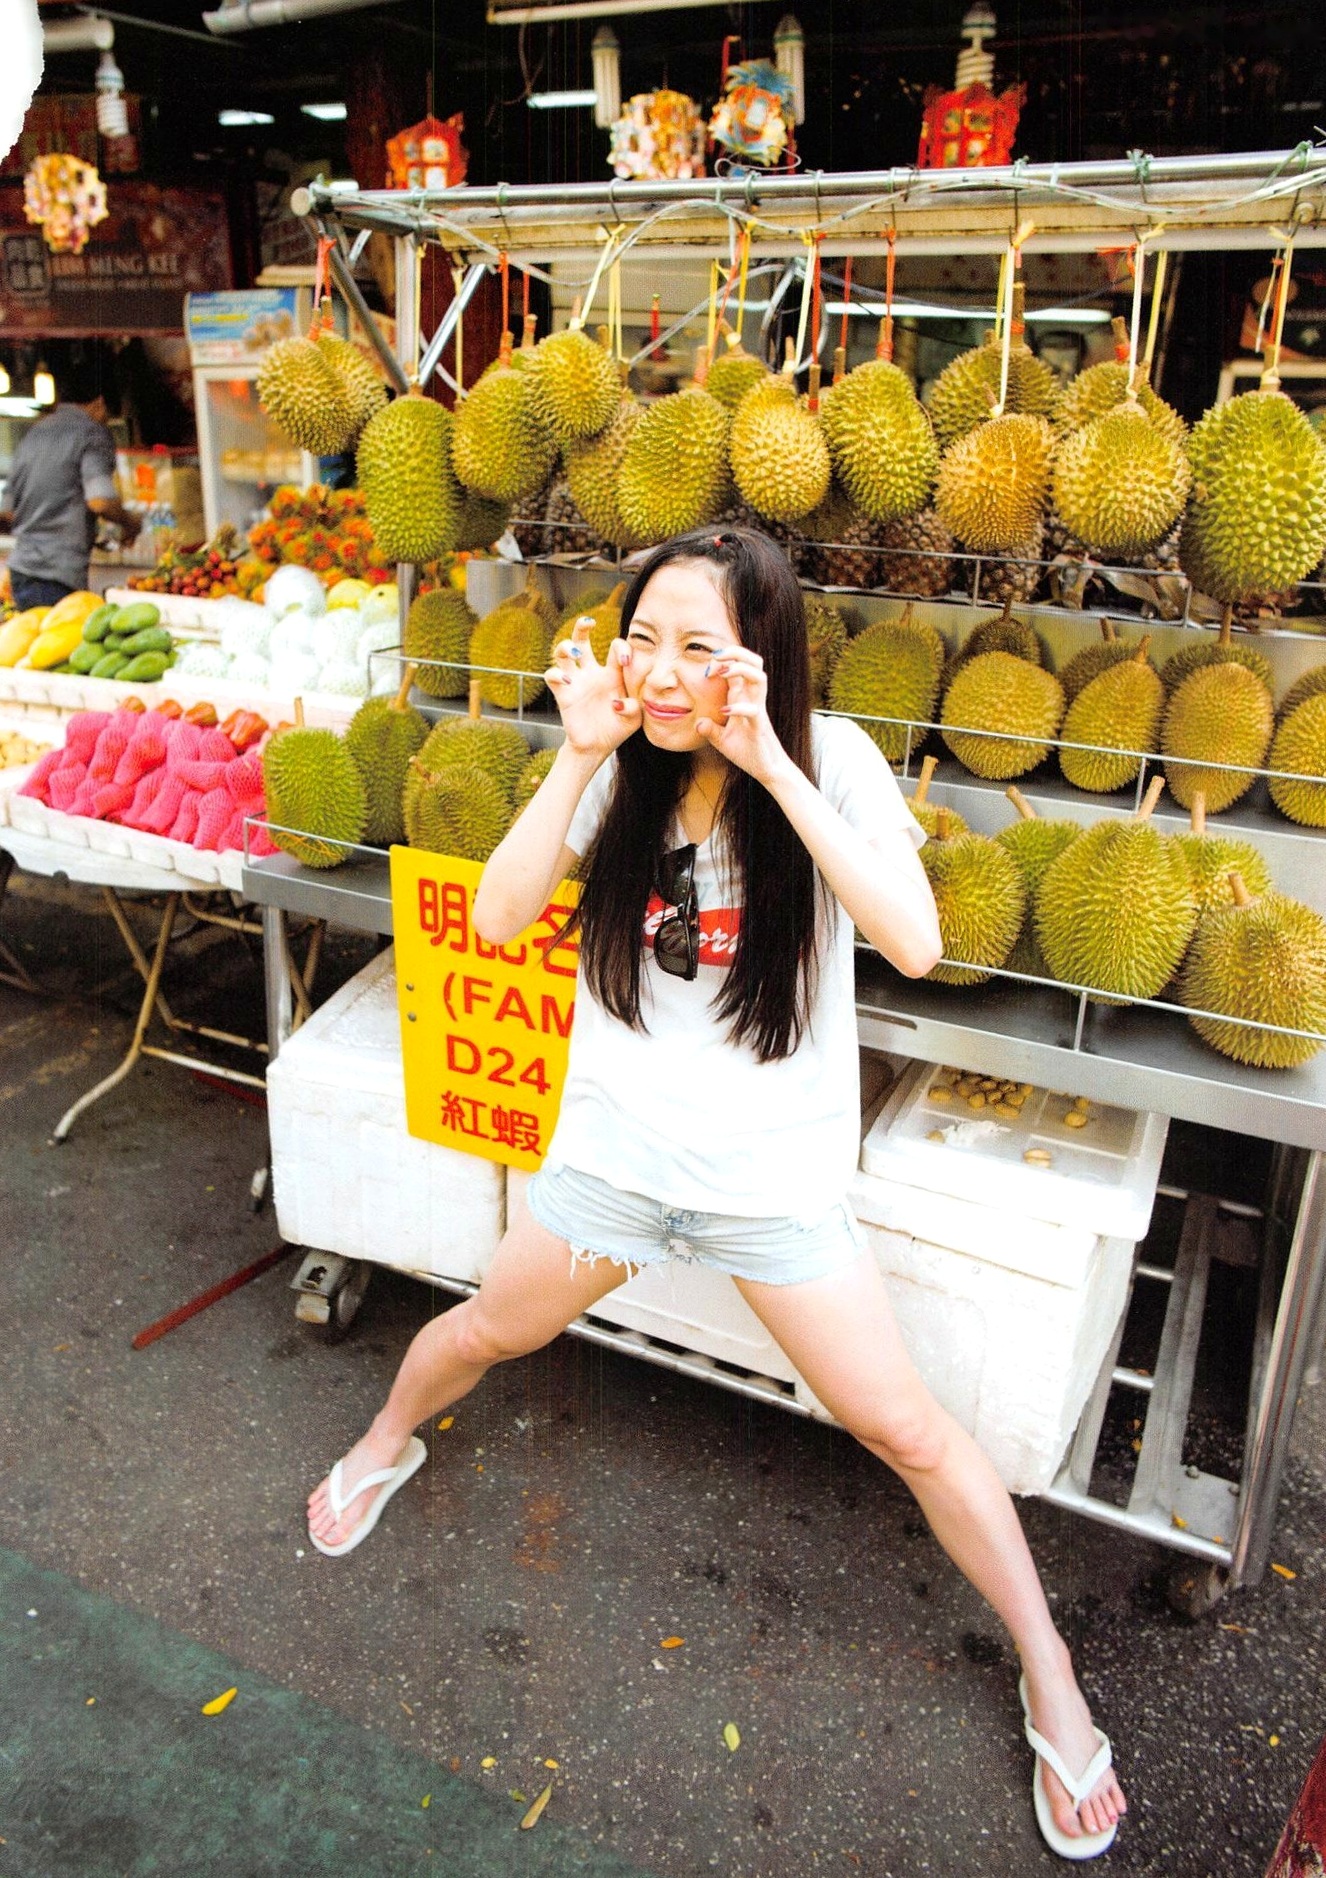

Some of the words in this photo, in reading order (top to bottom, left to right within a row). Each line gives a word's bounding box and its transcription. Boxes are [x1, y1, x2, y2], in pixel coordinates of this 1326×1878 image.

[418, 878, 578, 978] 明名
[446, 1034, 551, 1095] D24
[441, 1090, 542, 1156] 紅蝦
